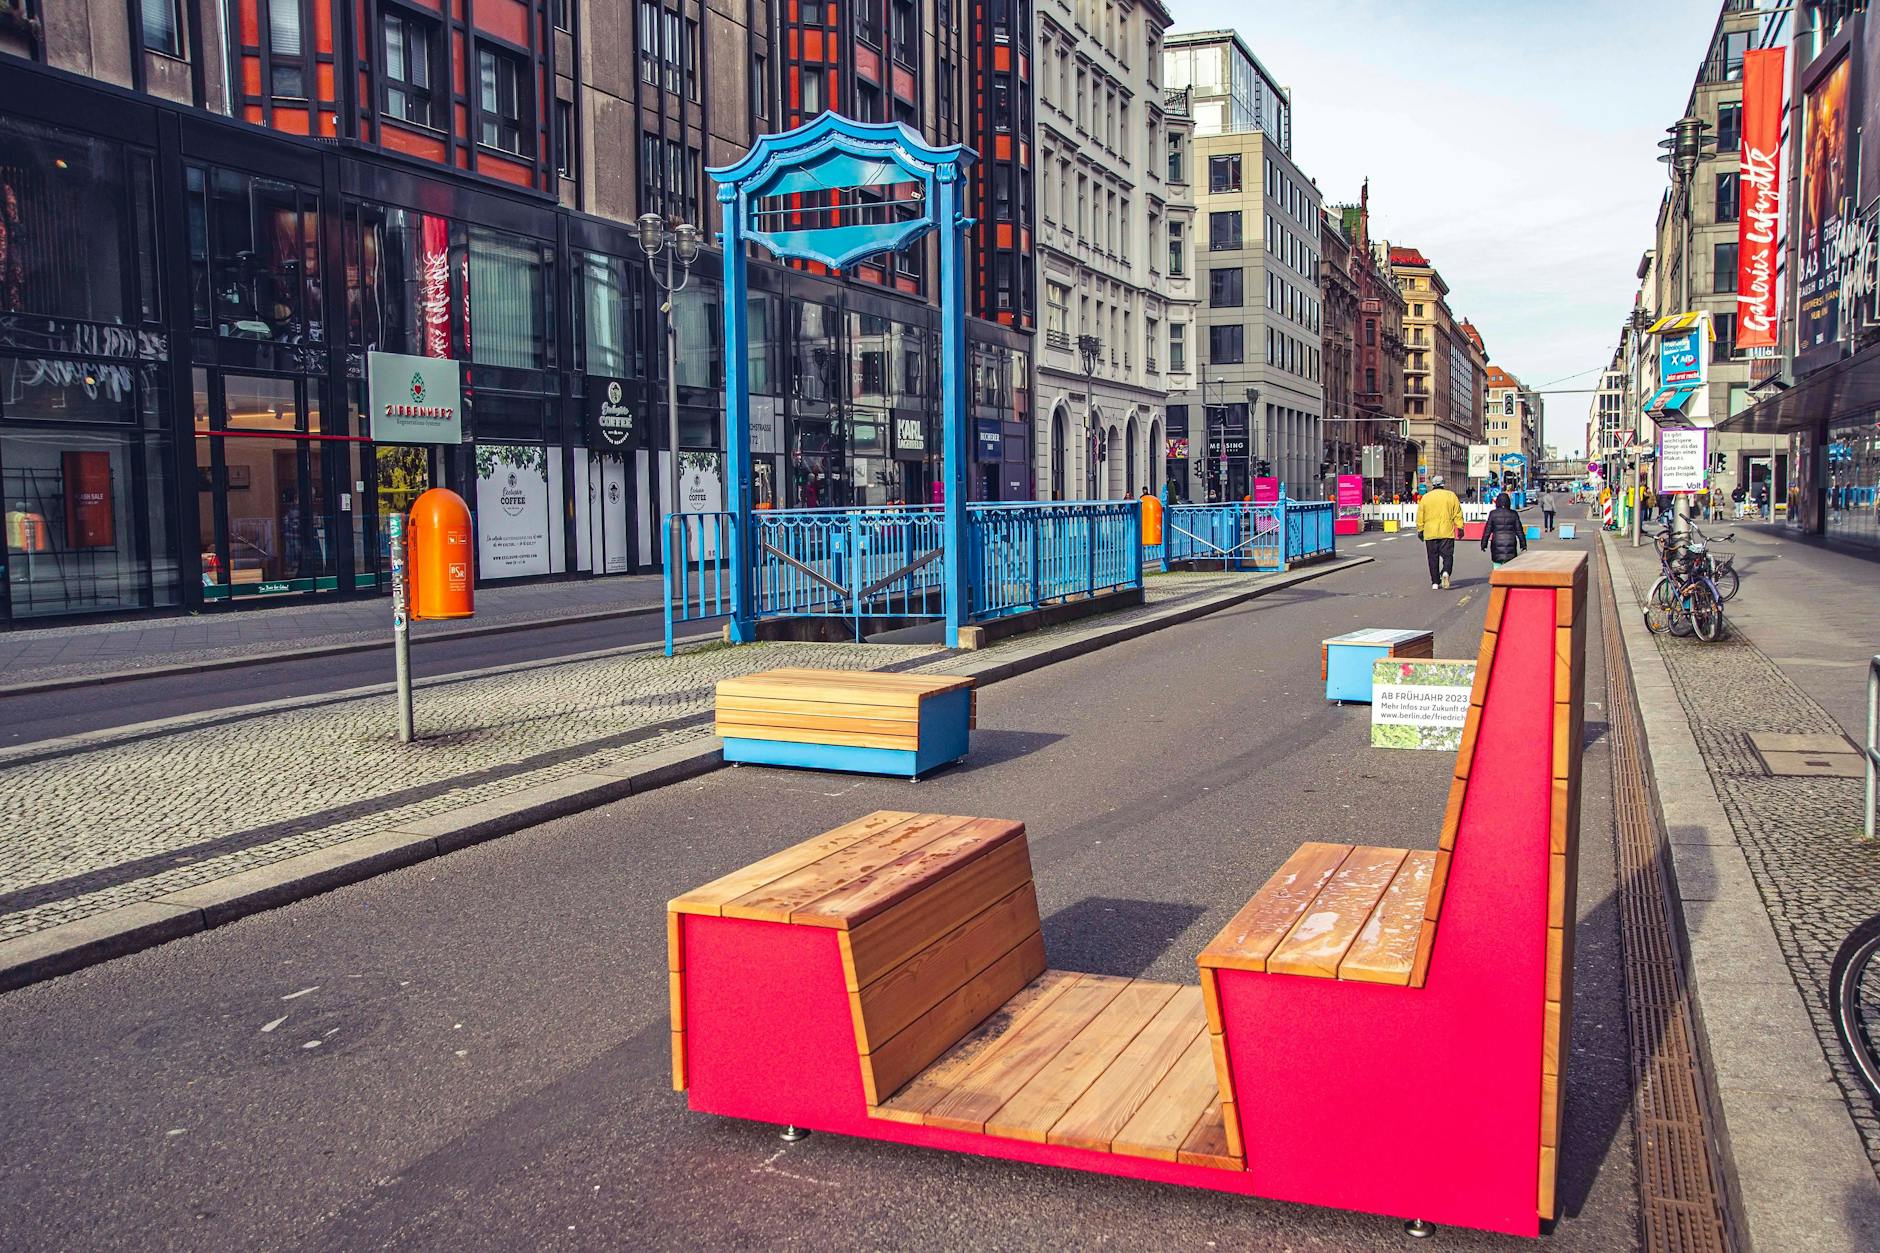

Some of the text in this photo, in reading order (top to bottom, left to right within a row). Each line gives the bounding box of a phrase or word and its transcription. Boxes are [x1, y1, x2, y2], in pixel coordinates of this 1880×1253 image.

[1737, 141, 1780, 332] Galeries Lafayette
[1680, 355, 1693, 363] AfD
[385, 404, 454, 420] ZIRBENHERZ
[599, 415, 632, 428] COFFEE
[897, 419, 924, 440] KARL
[1686, 482, 1702, 490] Volt
[500, 496, 526, 505] COFFEE
[1381, 690, 1468, 703] AB FRÜHJAHR 2023
[1381, 702, 1399, 710] Mehr
[1400, 703, 1418, 711] Infos
[1432, 704, 1459, 712] Zukunft
[1381, 712, 1466, 721] www.berlin.de/friedrich
